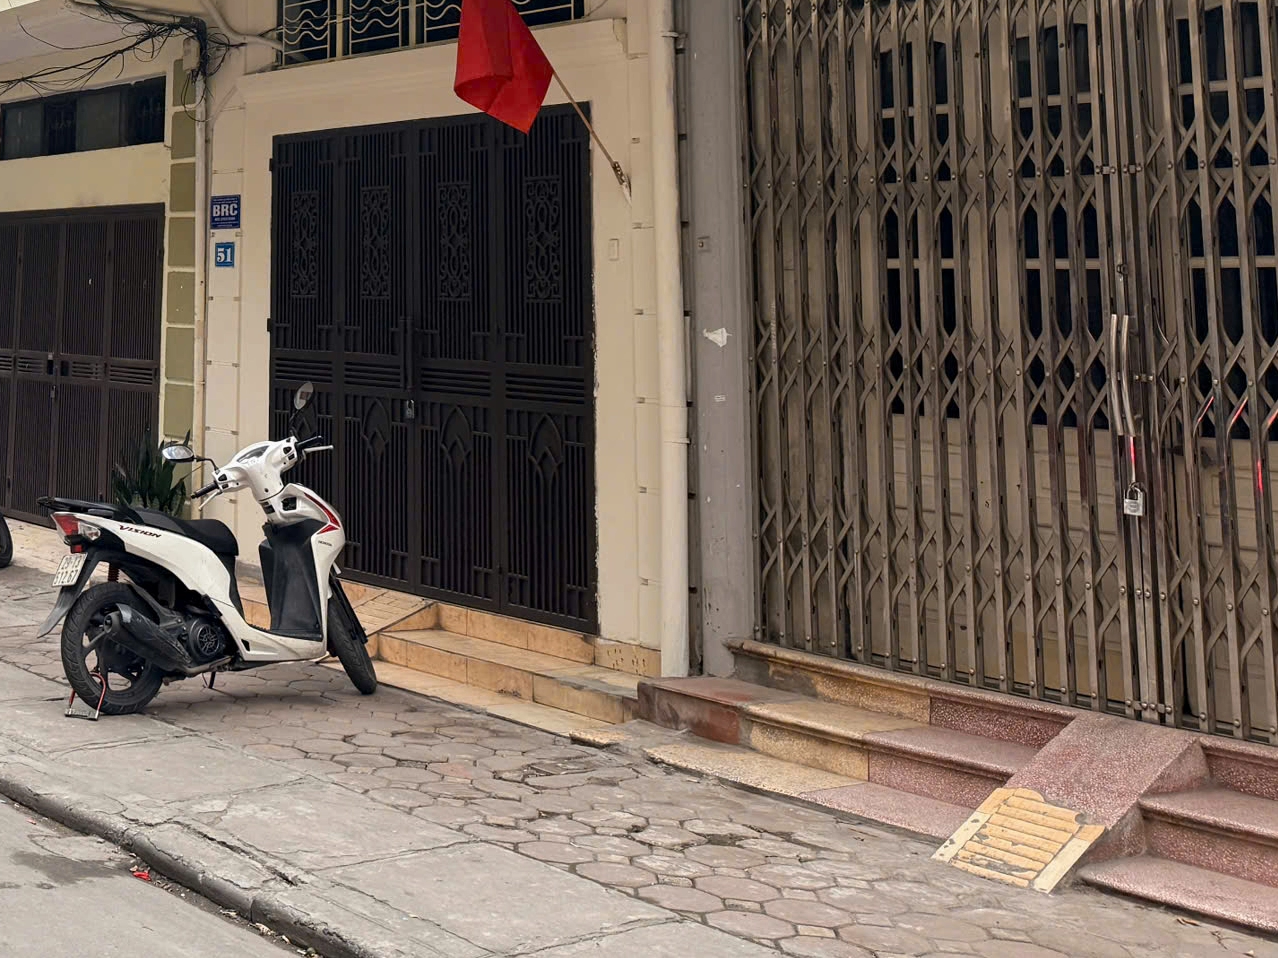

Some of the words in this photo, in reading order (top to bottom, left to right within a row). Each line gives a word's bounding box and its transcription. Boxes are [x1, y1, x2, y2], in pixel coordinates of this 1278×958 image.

[212, 203, 238, 217] BRC
[216, 247, 233, 263] 51
[119, 524, 162, 538] VISION
